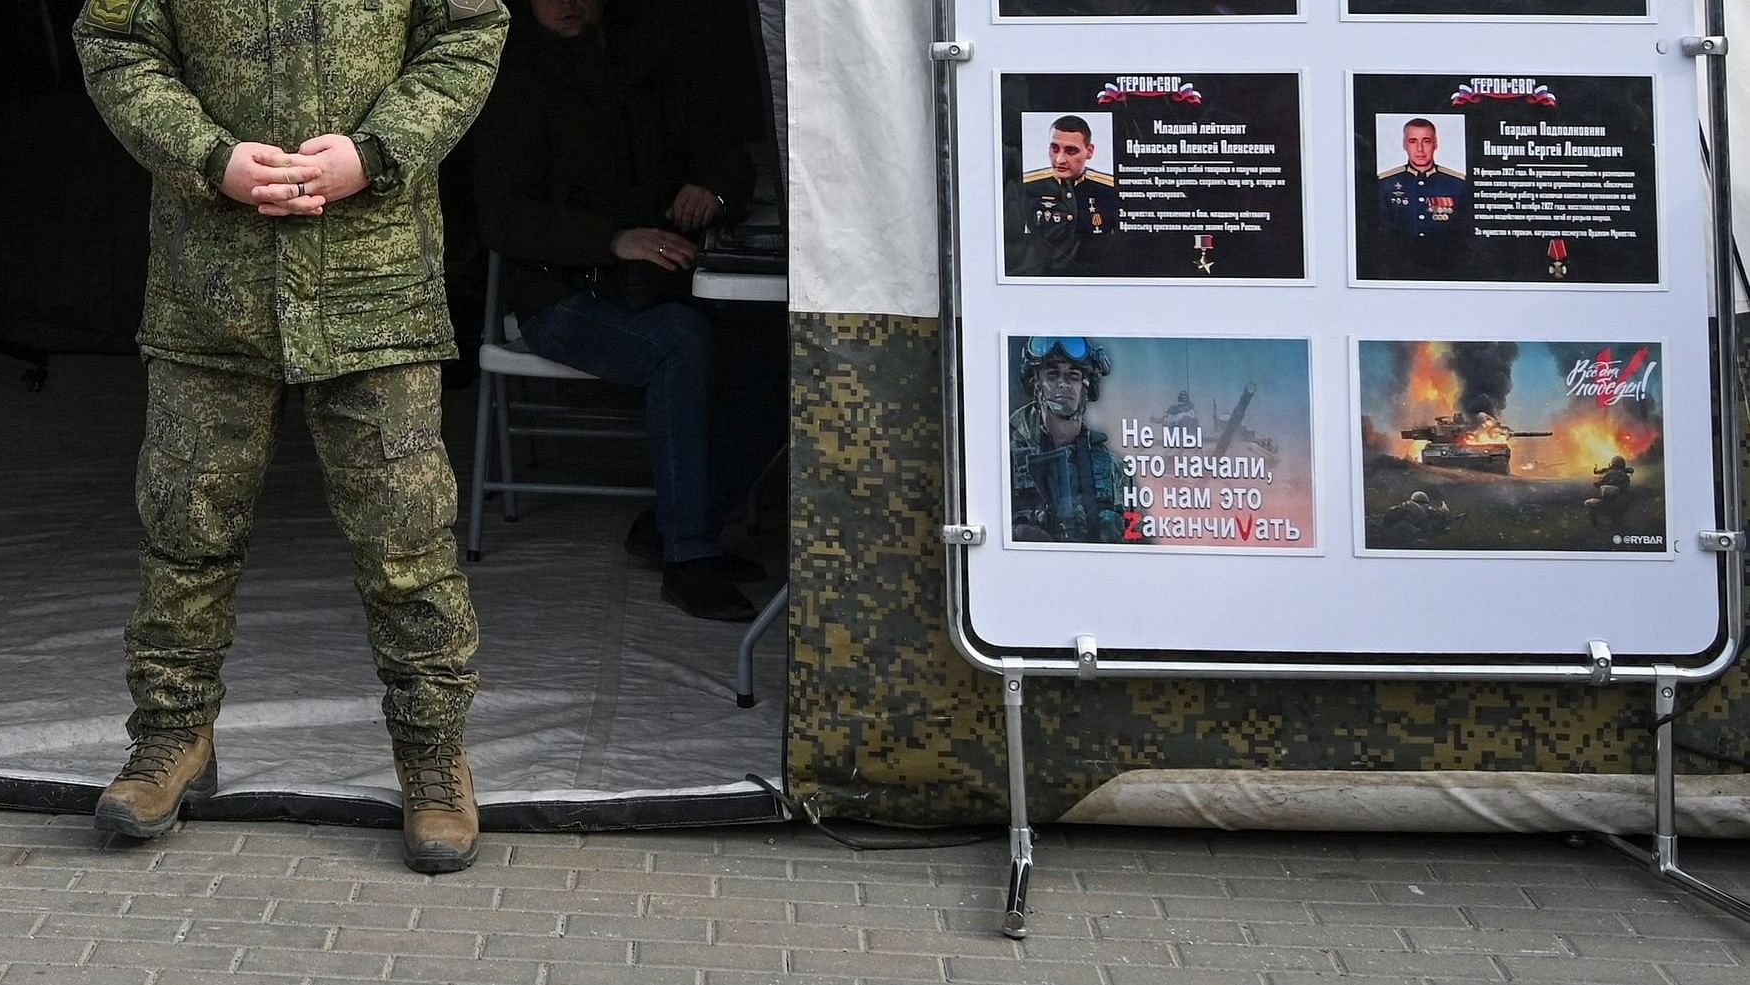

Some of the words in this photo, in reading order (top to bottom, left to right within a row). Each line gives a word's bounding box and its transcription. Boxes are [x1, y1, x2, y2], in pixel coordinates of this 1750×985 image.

[1154, 120, 1197, 135] Младший
[1200, 122, 1246, 134] лейтенант
[1126, 139, 1178, 157] Афанасьев
[1180, 139, 1219, 154] Алексей
[1221, 140, 1275, 154] Алексеевич
[1528, 141, 1562, 160] Сергей
[1564, 141, 1623, 157] Леонидович
[1122, 418, 1154, 448] Не
[1163, 427, 1202, 448] мы
[1123, 455, 1165, 477] это
[1174, 455, 1273, 483] начали,
[1123, 486, 1154, 508] но
[1163, 487, 1211, 509] нам
[1220, 488, 1262, 510] это
[1624, 535, 1663, 544] @RYBAR
